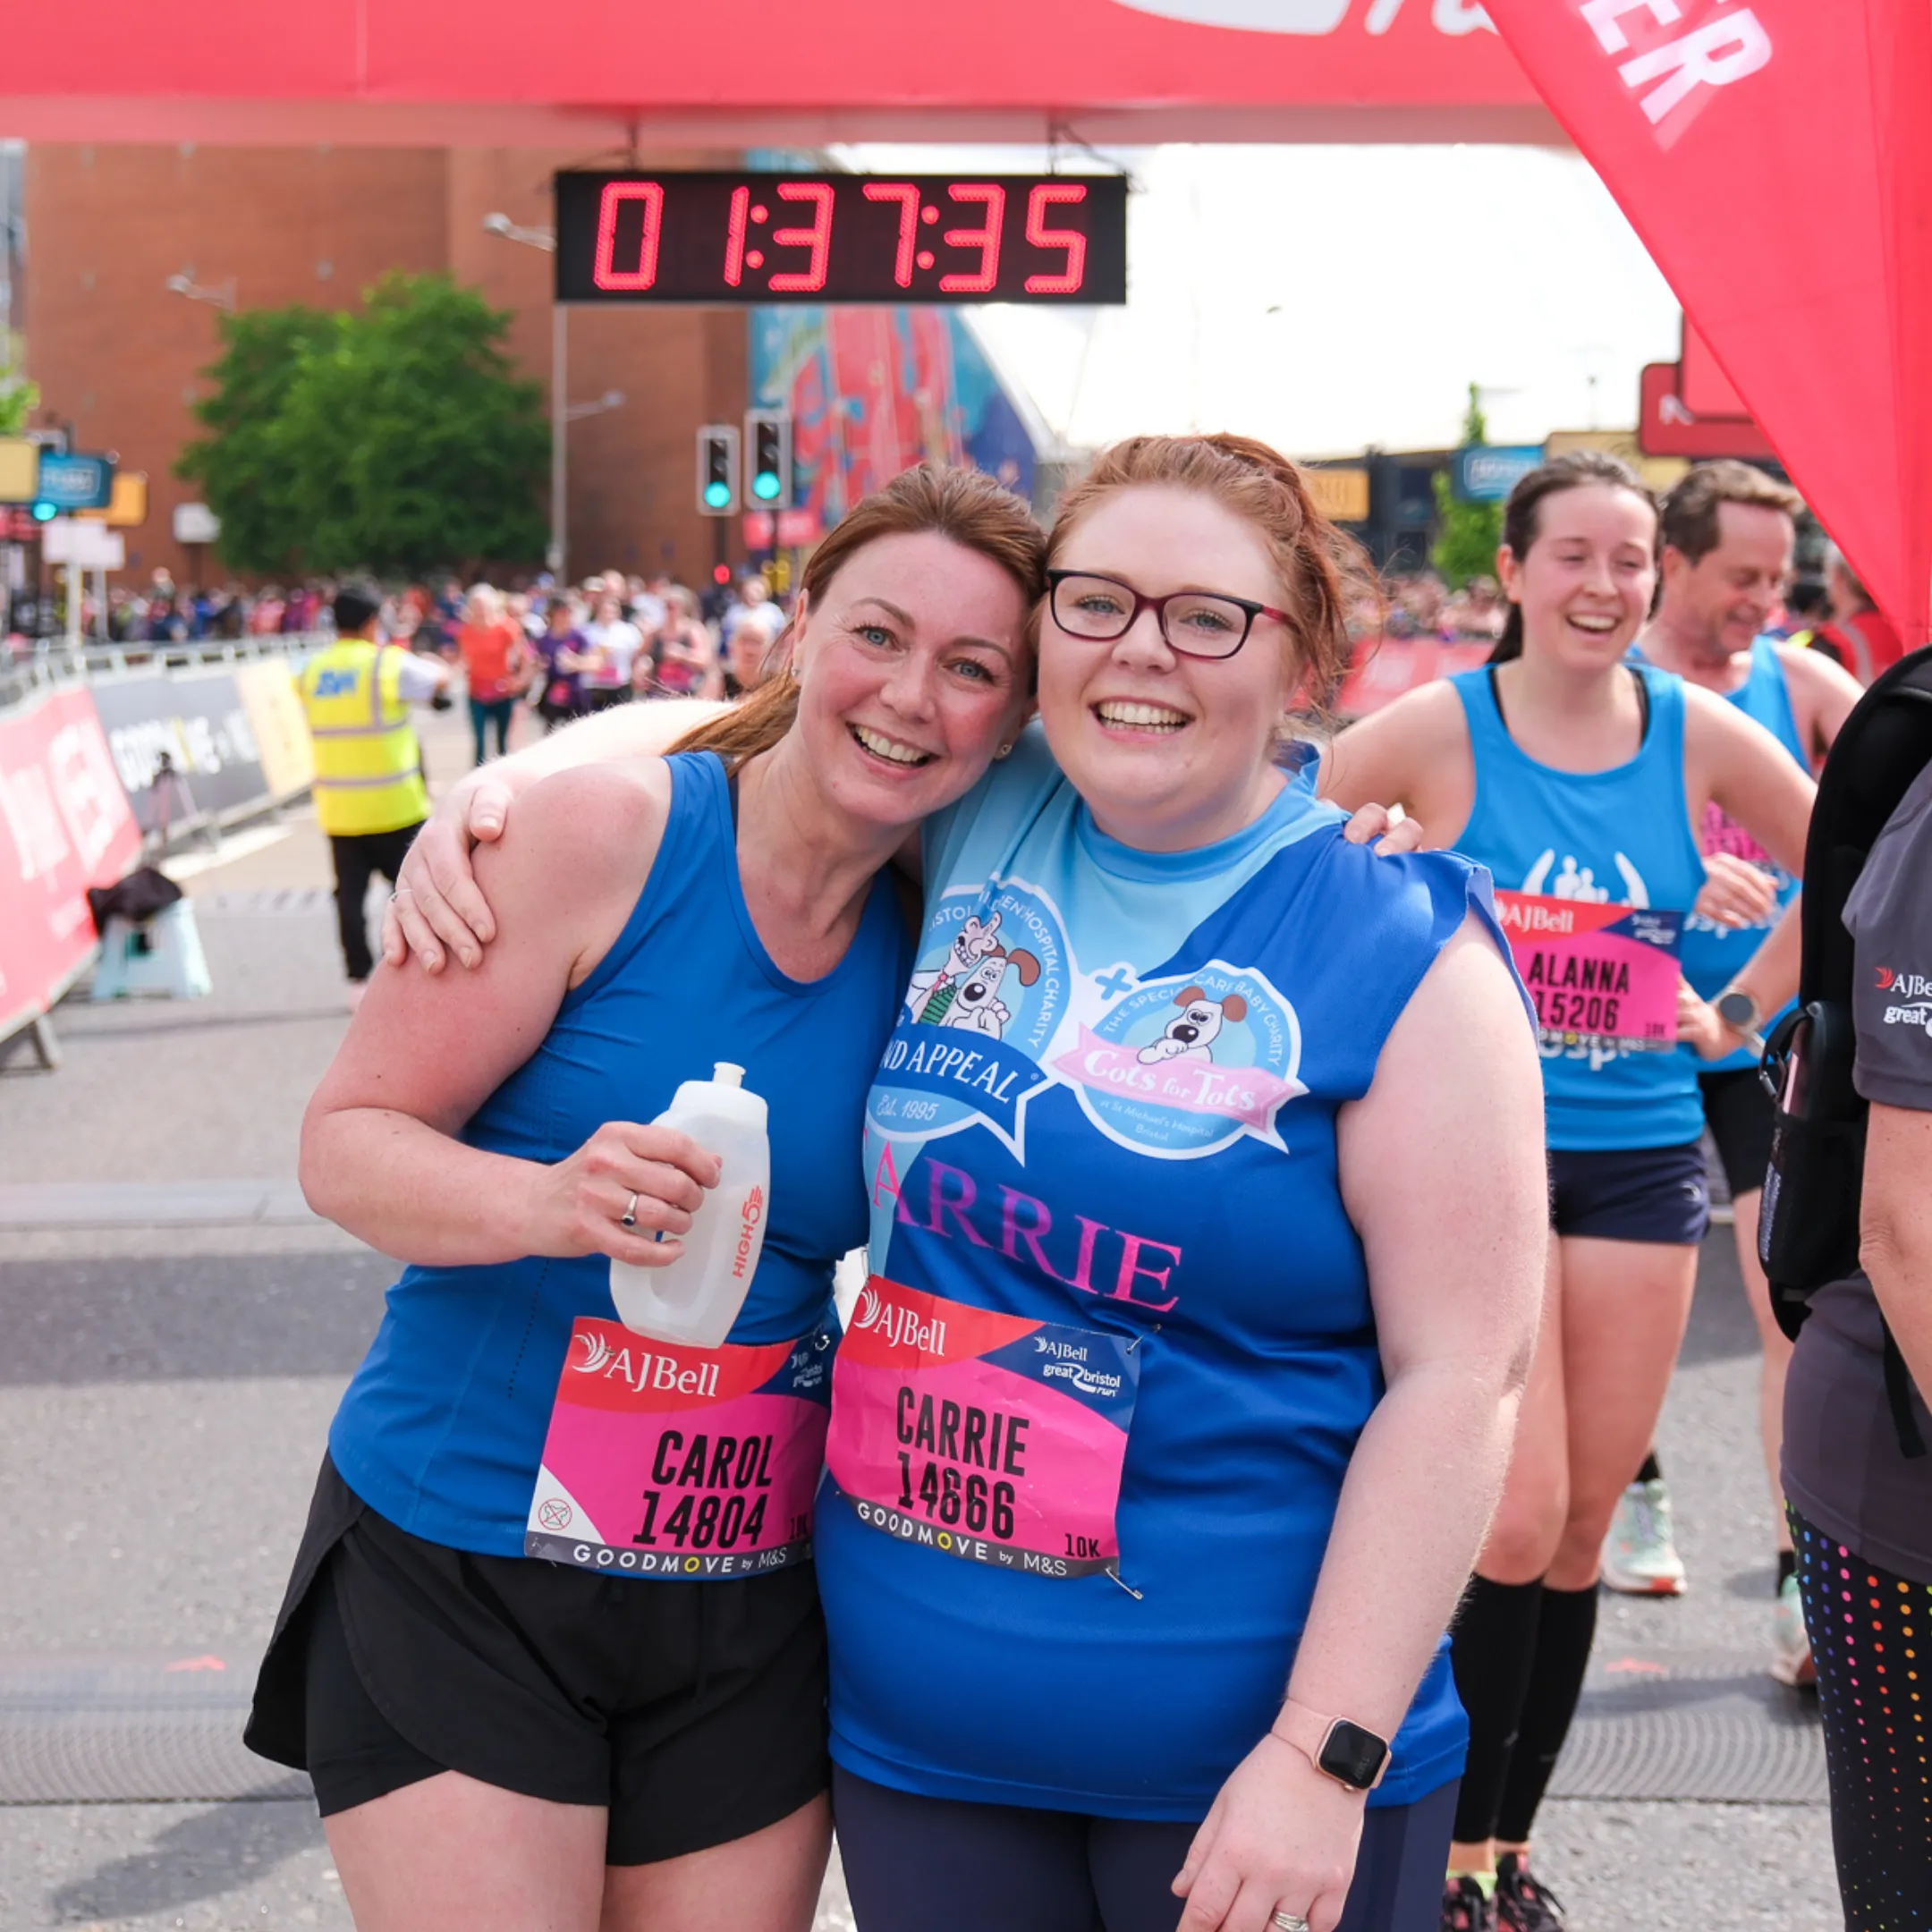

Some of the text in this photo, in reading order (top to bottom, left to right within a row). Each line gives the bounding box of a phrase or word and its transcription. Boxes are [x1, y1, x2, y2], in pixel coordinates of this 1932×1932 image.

[1528, 953, 1630, 995] ALANNA
[1890, 972, 1932, 998] AJBe
[1028, 978, 1060, 1048] CHARITY
[1103, 1008, 1130, 1033] THE
[1129, 985, 1185, 1009] SPECIA
[1234, 980, 1270, 1013] BABY
[1264, 1013, 1283, 1067] CHARITY
[1536, 990, 1620, 1031] 15206
[1884, 1005, 1928, 1025] great
[906, 1041, 1018, 1104] APPEAL
[1084, 1050, 1255, 1110] Cots for Tots
[902, 1100, 939, 1120] 1995
[1172, 1120, 1215, 1137] Hospital
[1135, 1124, 1169, 1140] Bristol
[863, 1128, 1182, 1312] ARRIE
[1043, 1364, 1121, 1387] great bristol
[1097, 1387, 1116, 1397] run
[896, 1386, 1030, 1477] CARRIE
[651, 1429, 773, 1488] CAROL
[896, 1451, 1015, 1539] 14666
[632, 1490, 766, 1548] 14804
[857, 1502, 1067, 1577] GOODMOVE by M&S
[573, 1544, 786, 1572] GOODMOVE by M&S
[1064, 1533, 1101, 1558] 10K
